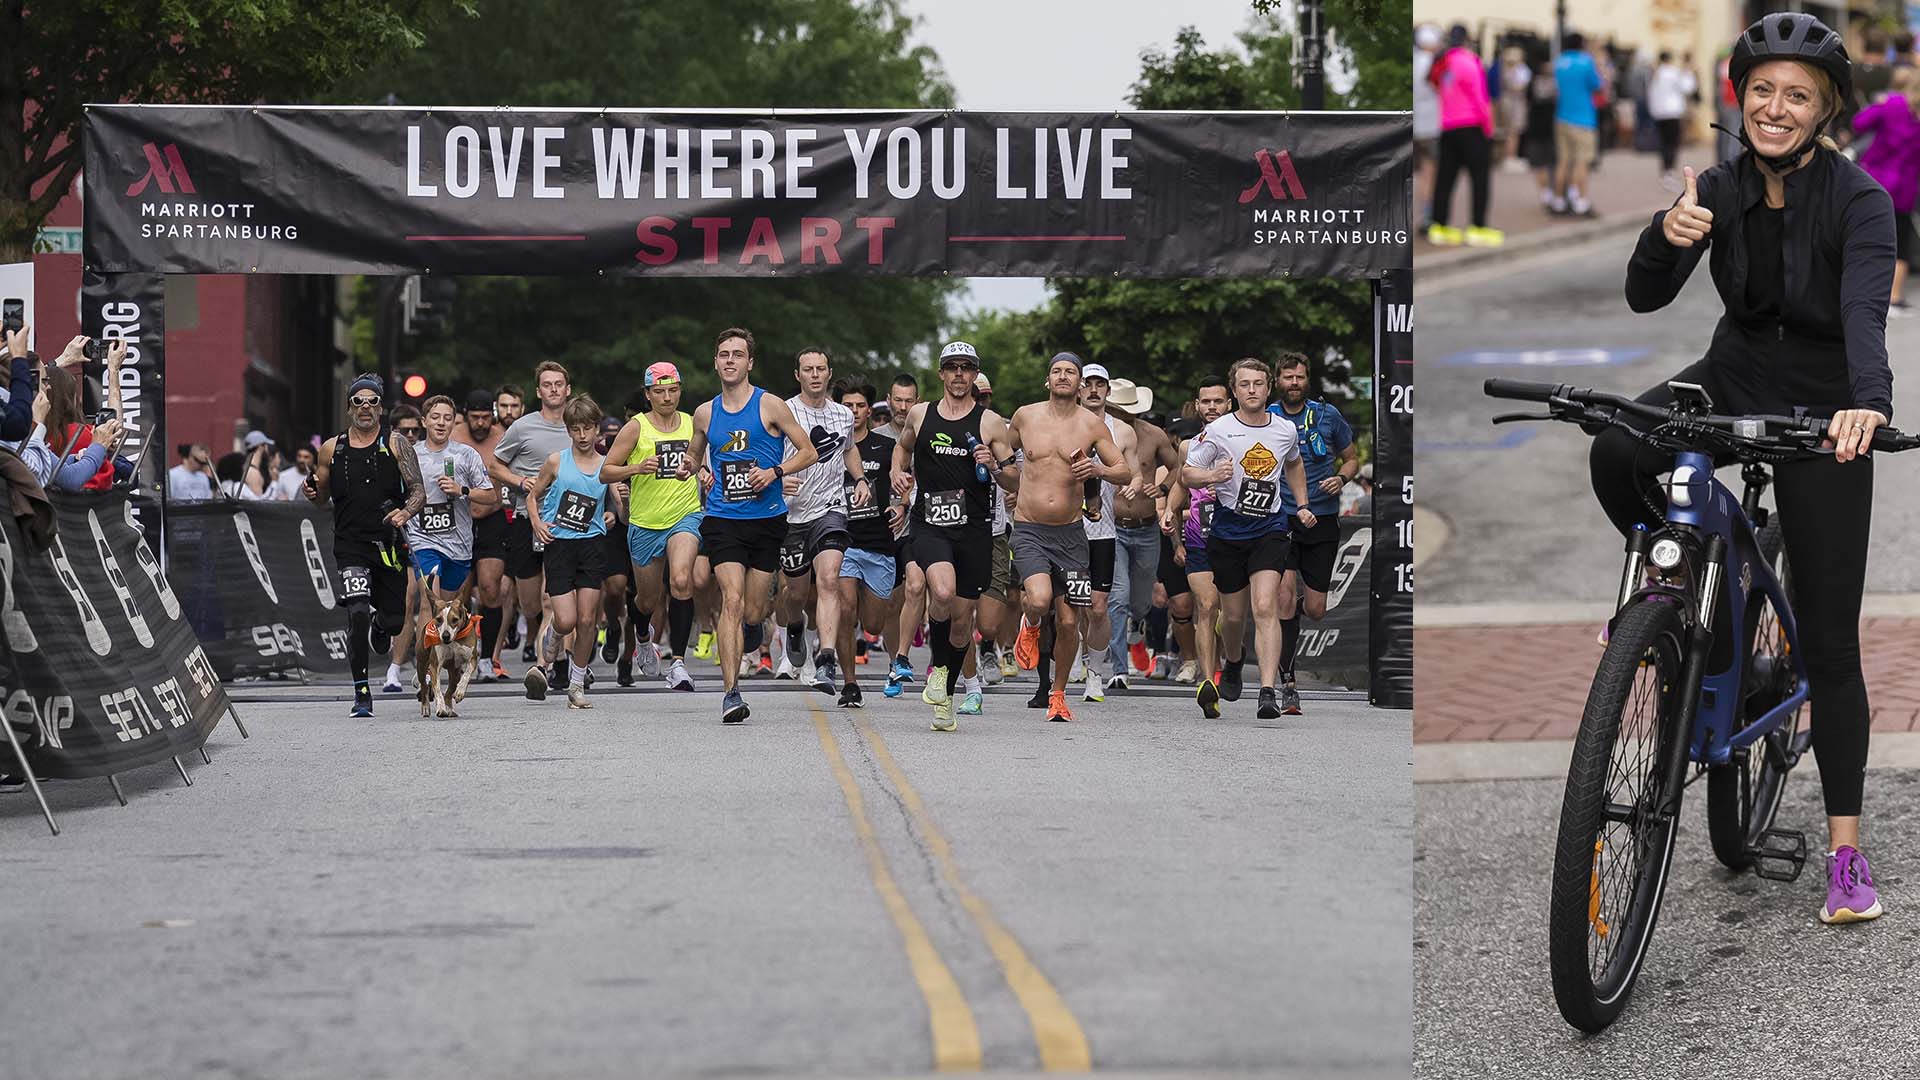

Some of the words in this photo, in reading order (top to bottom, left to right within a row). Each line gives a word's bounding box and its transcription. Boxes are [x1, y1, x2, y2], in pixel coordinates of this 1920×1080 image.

[406, 126, 565, 198] LOVE
[592, 127, 817, 200] WHERE
[844, 127, 966, 200] YOU
[996, 127, 1133, 200] LIVE
[141, 203, 255, 218] MARRIOTT
[1254, 209, 1365, 224] MARRIOTT
[141, 223, 297, 240] SPARTANBURG
[1254, 230, 1408, 244] SPARTANBURG
[635, 216, 896, 265] START
[661, 451, 686, 468] 120
[726, 473, 752, 490] 265
[1242, 490, 1271, 508] 277
[566, 504, 586, 521] 44
[931, 503, 961, 522] 250
[423, 513, 452, 530] 266
[780, 552, 804, 568] 217
[343, 576, 368, 593] 132
[1066, 580, 1092, 596] 276
